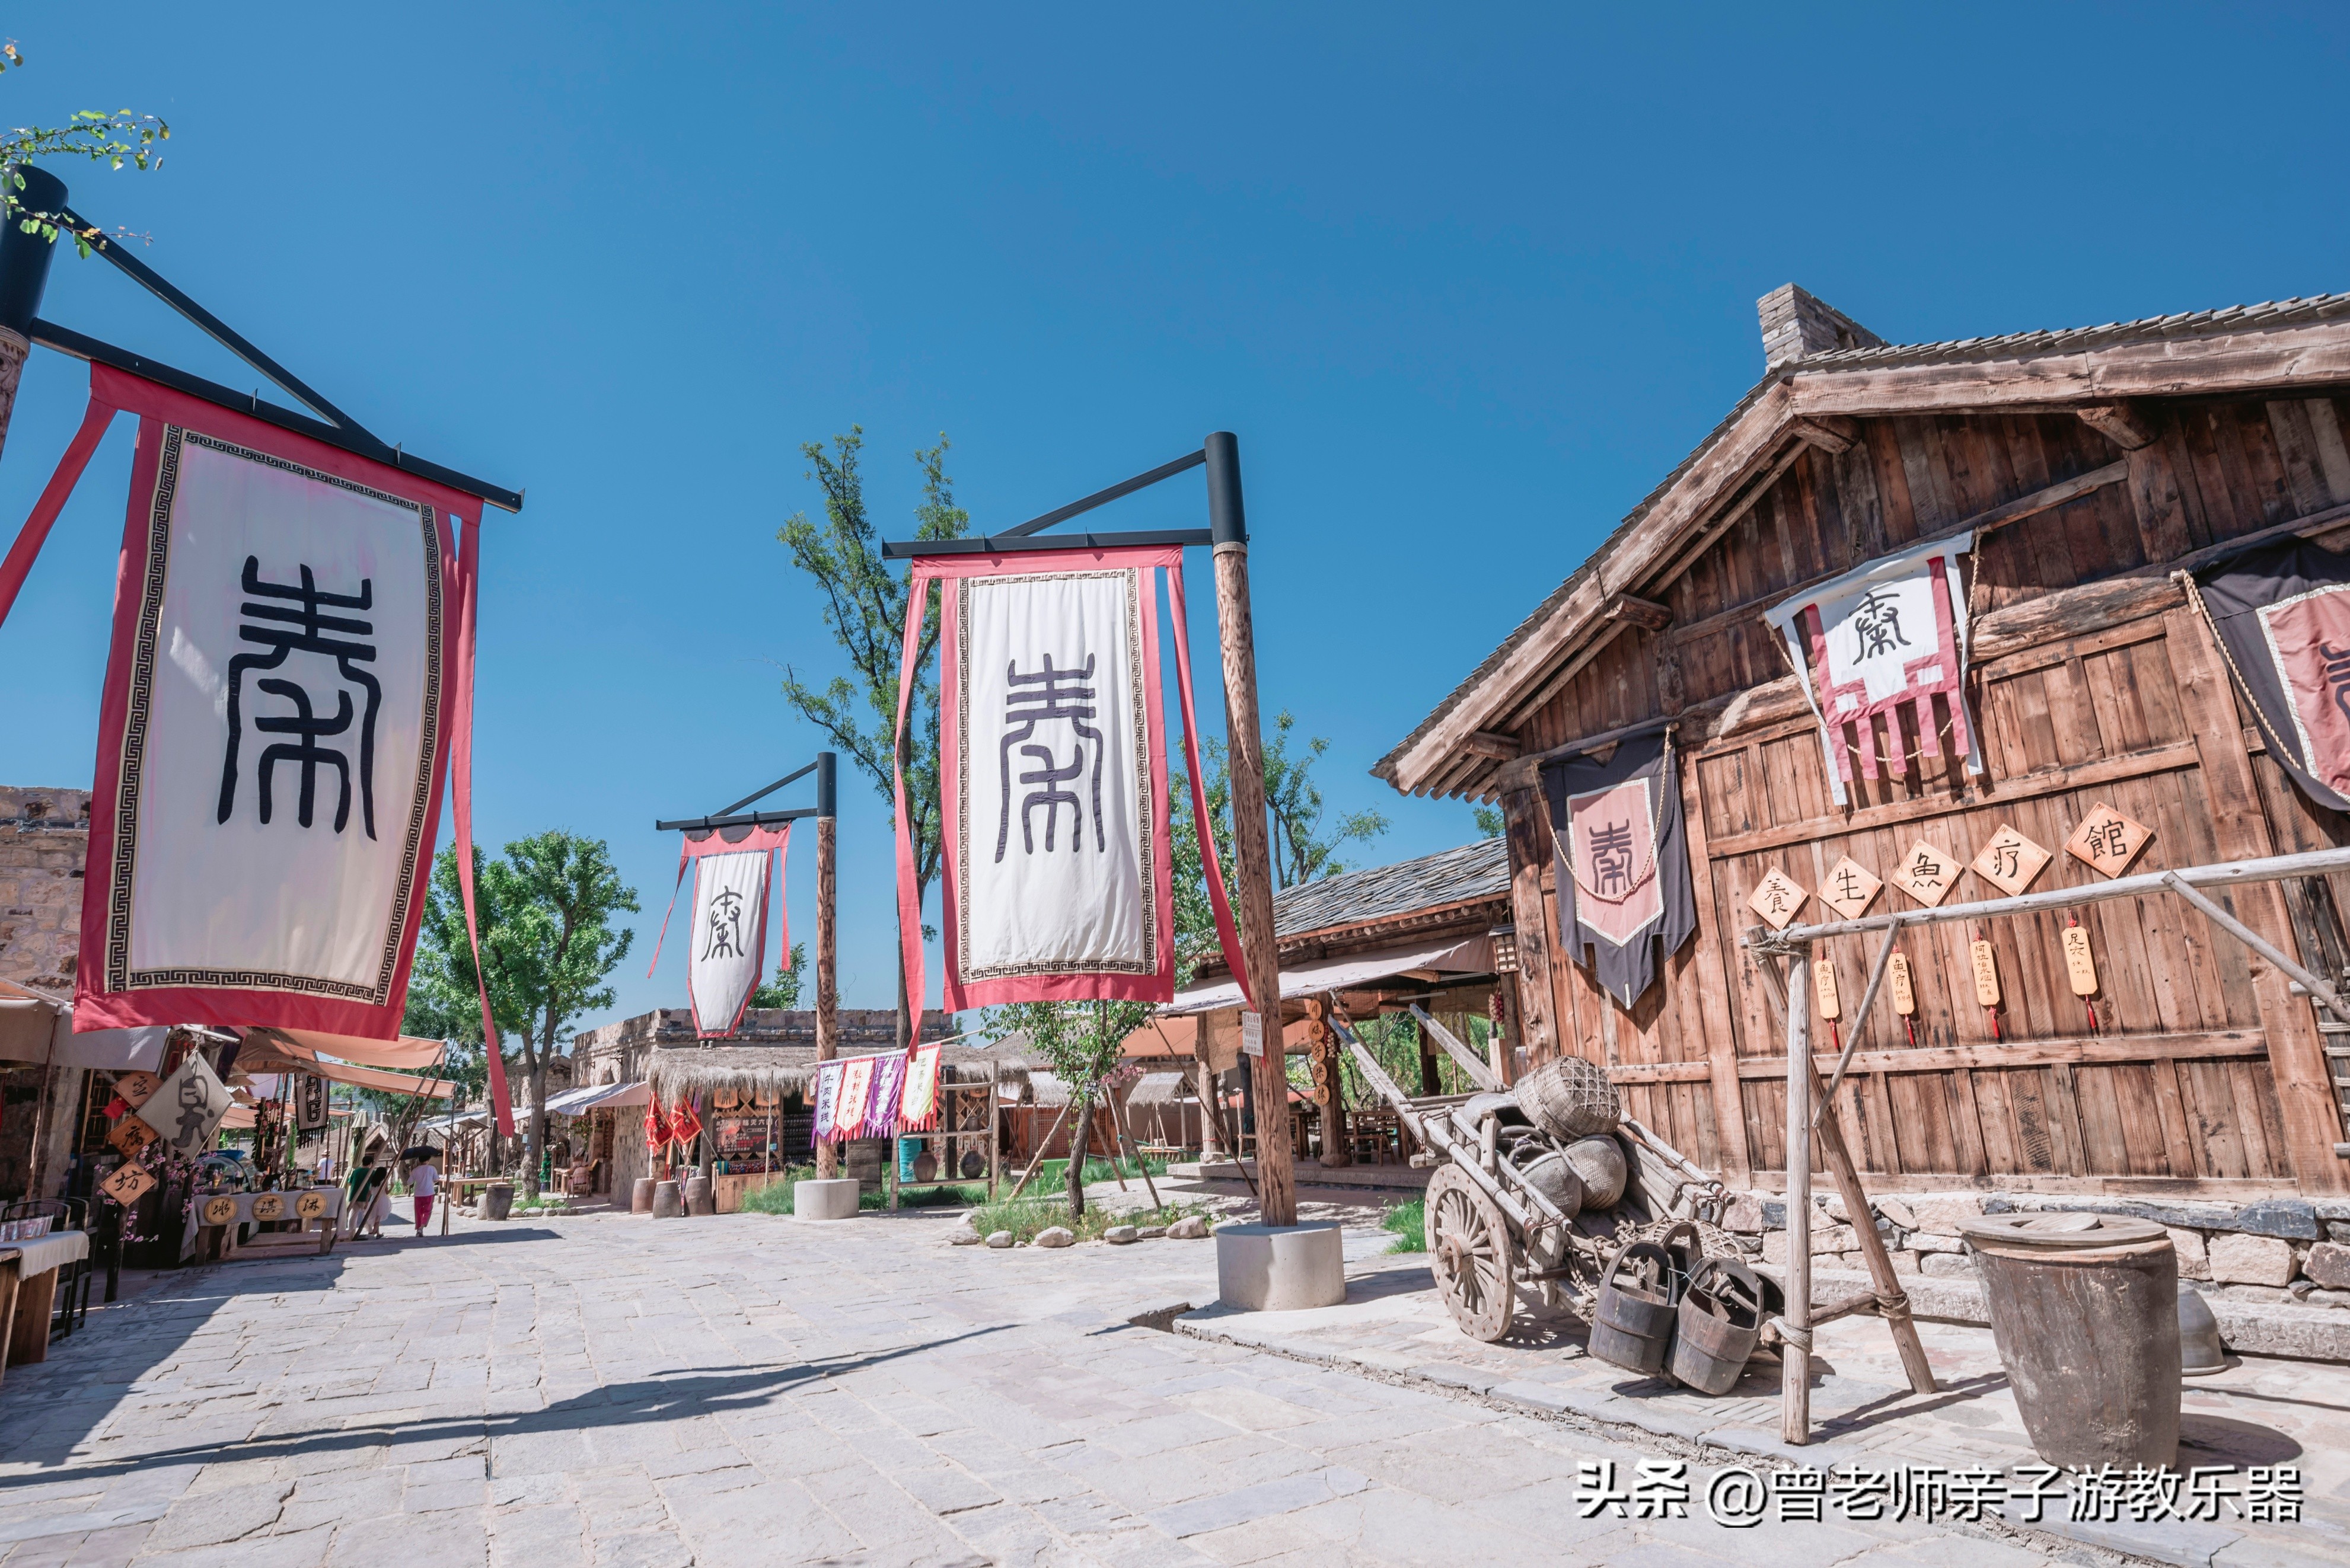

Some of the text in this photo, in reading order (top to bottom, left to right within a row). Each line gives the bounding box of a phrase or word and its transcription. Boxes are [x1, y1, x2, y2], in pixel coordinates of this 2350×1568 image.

[820, 1074, 834, 1123] 牛肉米线
[212, 1197, 320, 1216] 冰淇淋
